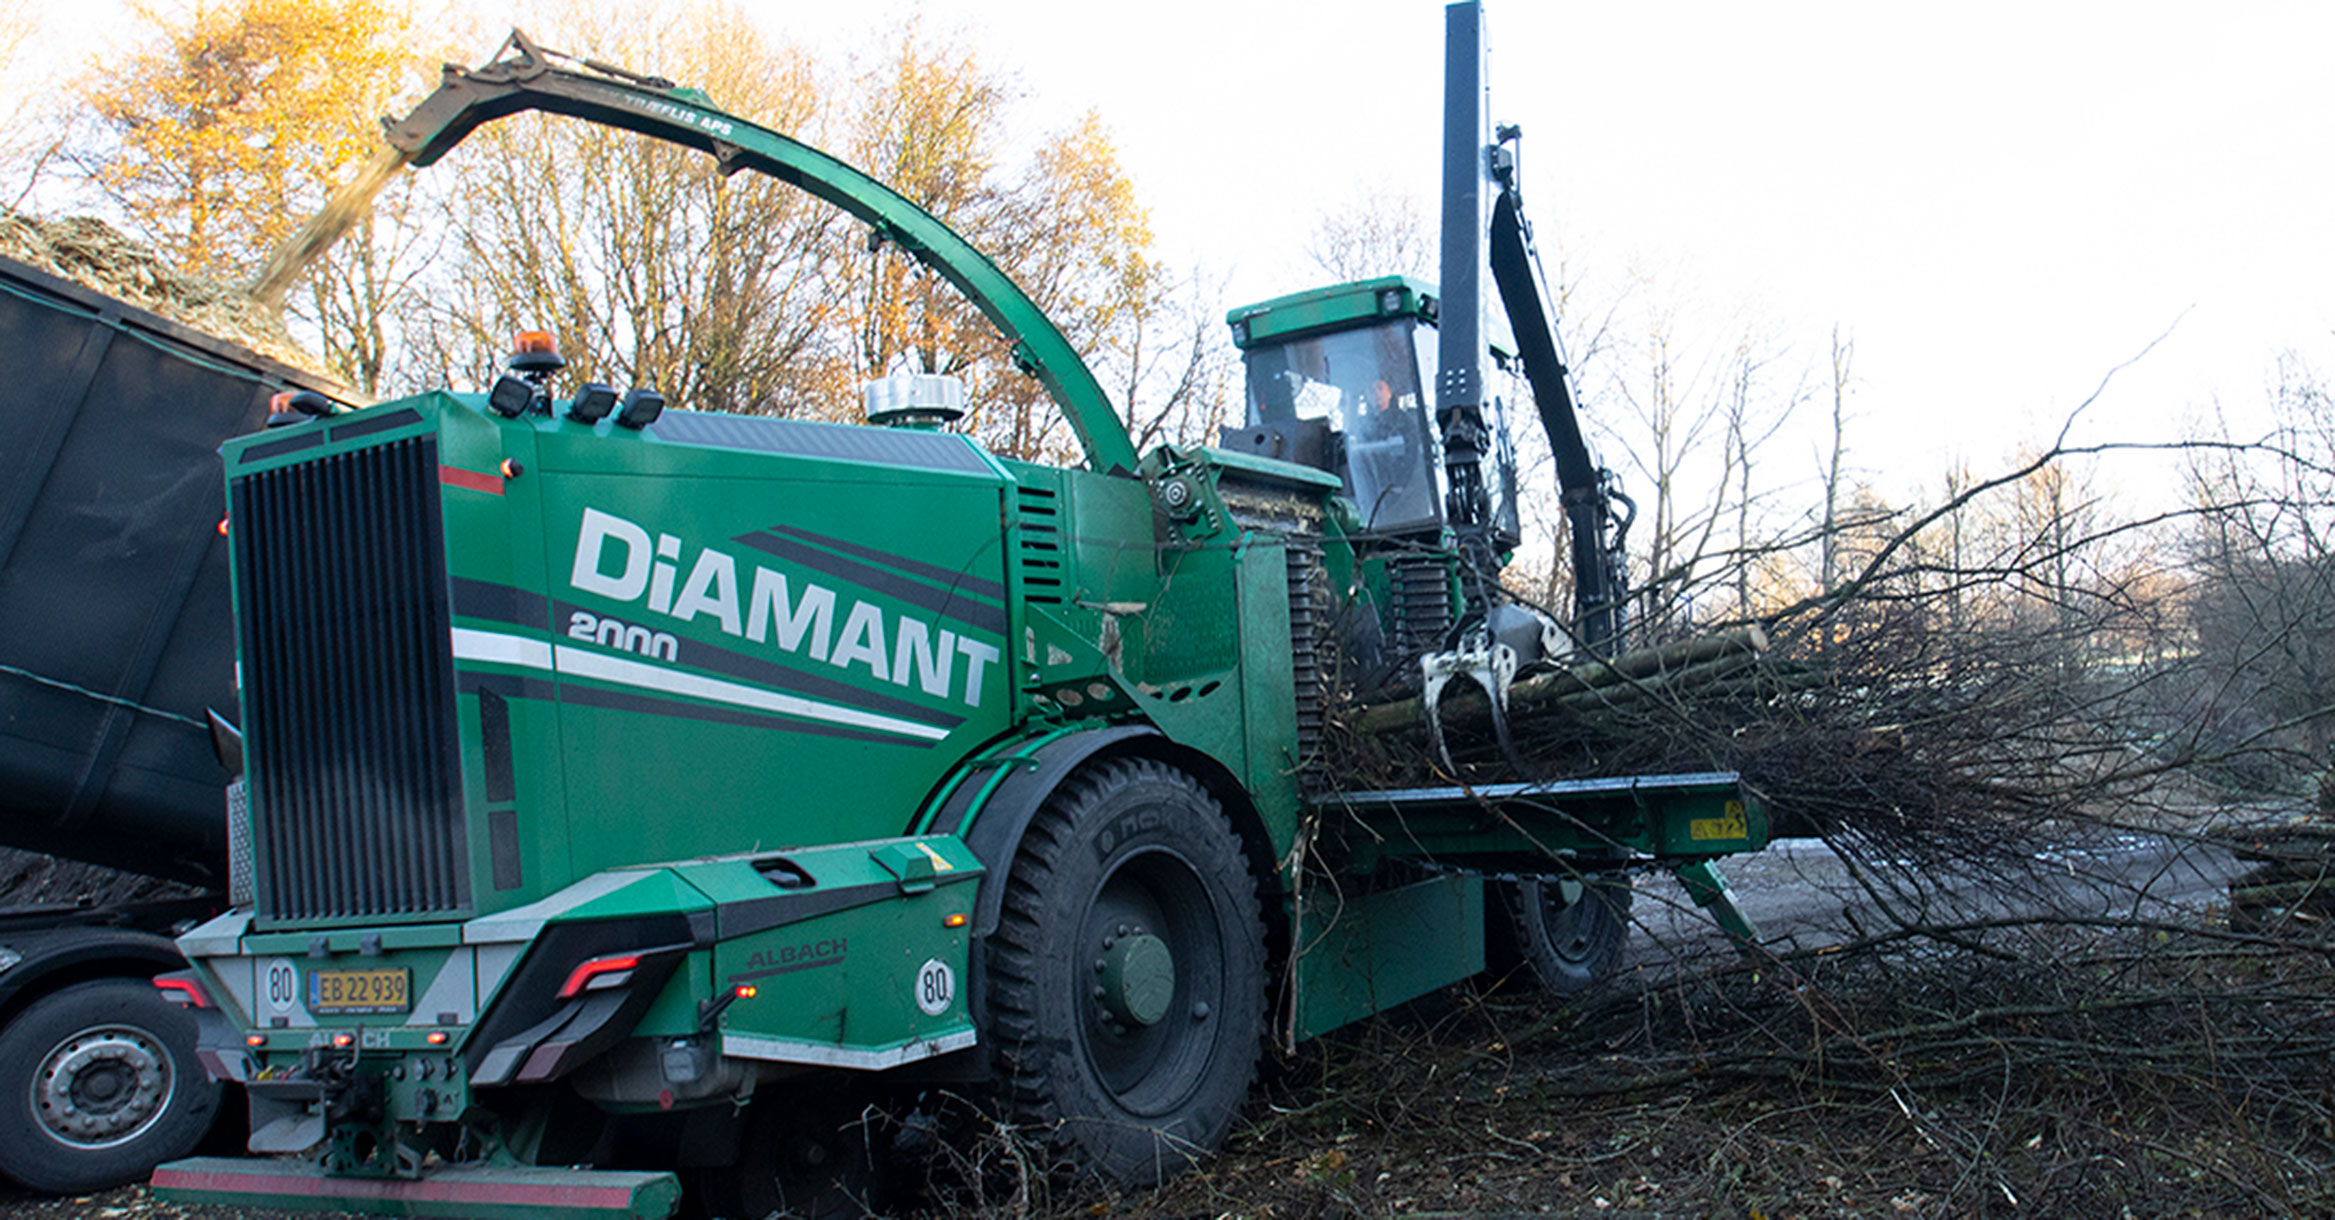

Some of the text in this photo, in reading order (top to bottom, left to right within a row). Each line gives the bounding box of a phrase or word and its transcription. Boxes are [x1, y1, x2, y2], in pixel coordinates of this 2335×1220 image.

[700, 116, 734, 136] APS
[567, 610, 680, 664] 2000
[746, 937, 849, 970] ALBACH
[270, 966, 293, 1003] 80
[321, 974, 405, 1002] EB 22 939
[923, 967, 947, 1004] 80
